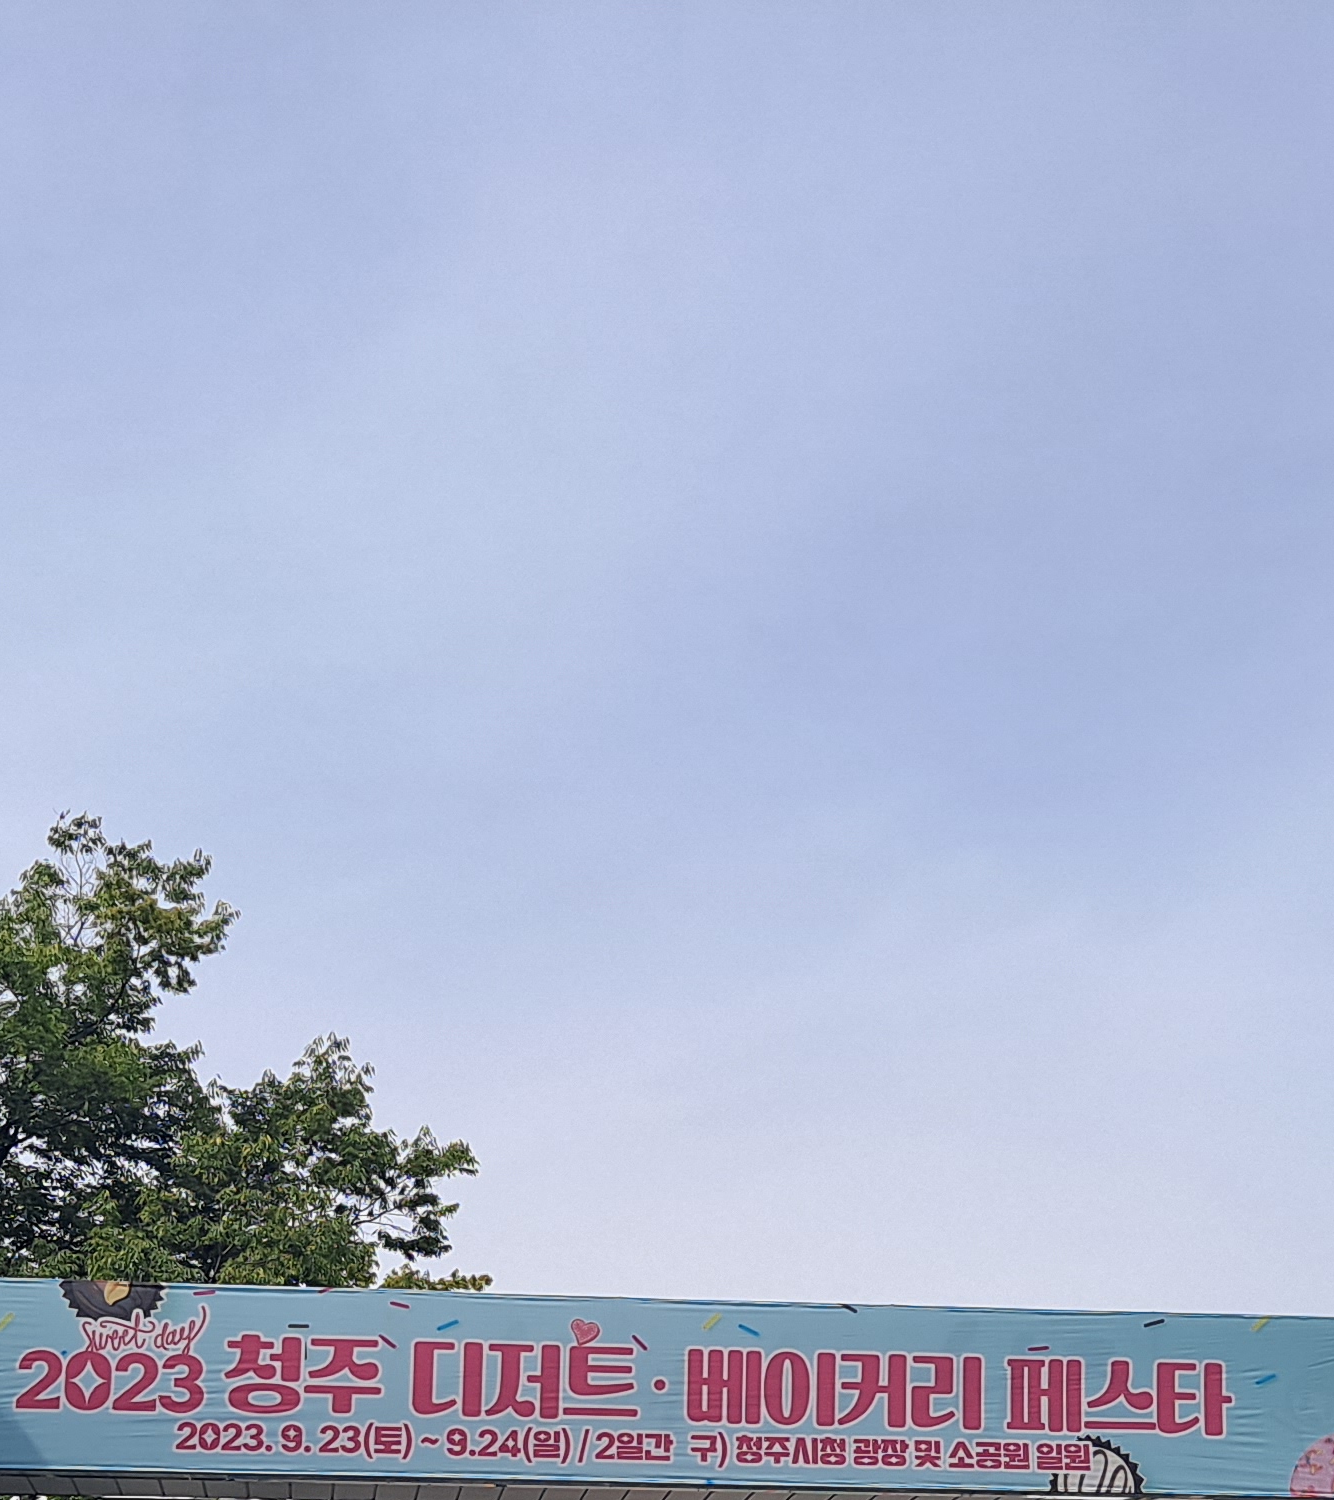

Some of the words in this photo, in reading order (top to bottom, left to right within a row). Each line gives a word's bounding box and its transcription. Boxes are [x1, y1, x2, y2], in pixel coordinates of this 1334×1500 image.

[154, 1305, 207, 1355] day
[14, 1348, 206, 1414] 2023
[223, 1334, 384, 1414] 청주
[1007, 1357, 1234, 1436] 페스타
[853, 1439, 910, 1466] 광장
[914, 1440, 943, 1469] 및
[949, 1441, 1031, 1470] 소공원
[1036, 1442, 1092, 1471] 일원
